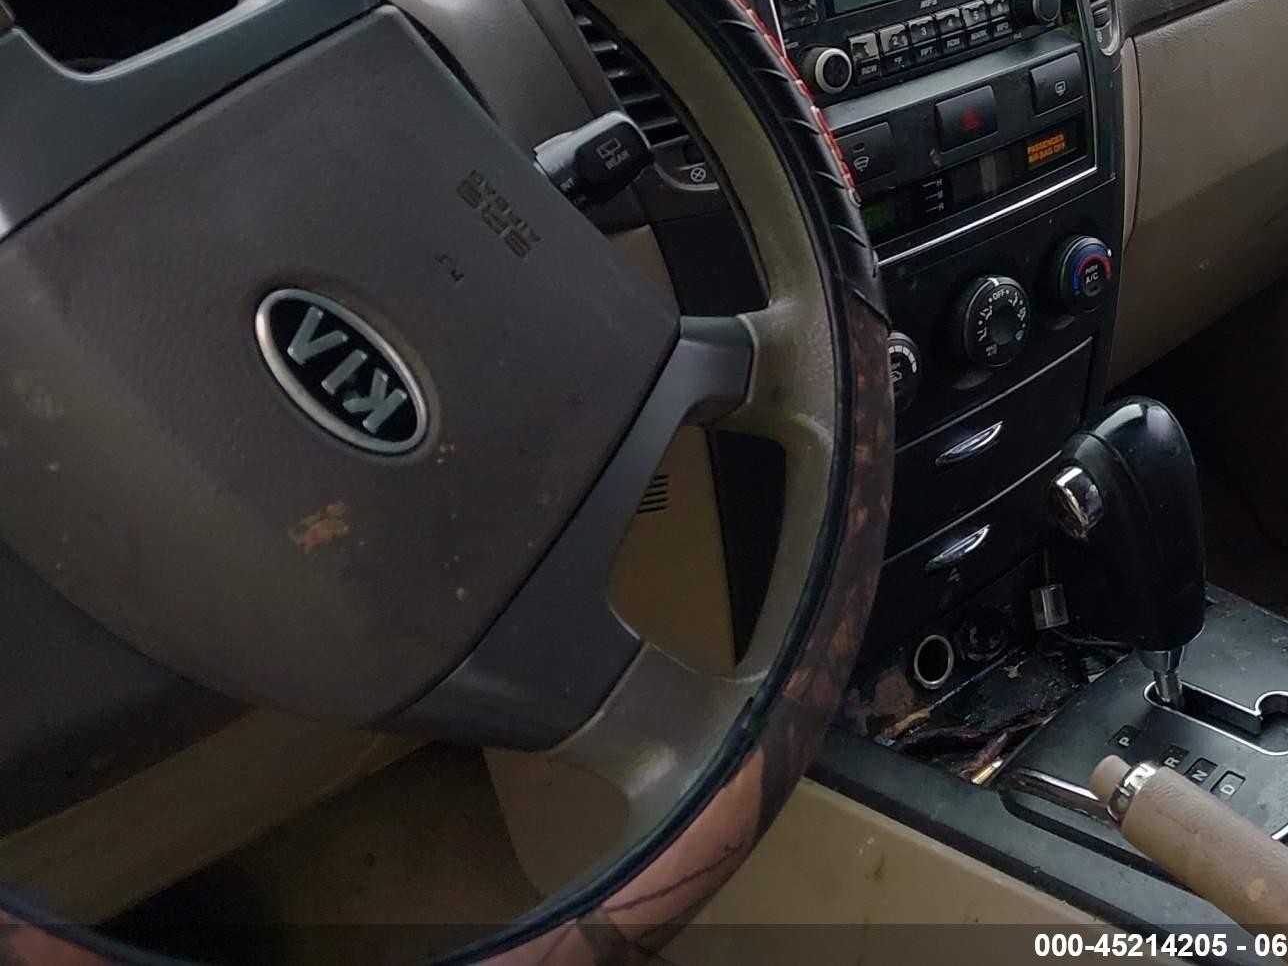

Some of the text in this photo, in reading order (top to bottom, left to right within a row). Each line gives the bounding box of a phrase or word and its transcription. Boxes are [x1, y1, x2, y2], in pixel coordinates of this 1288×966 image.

[972, 10, 980, 21] 5
[920, 26, 927, 36] 3
[891, 35, 899, 46] 2
[1085, 272, 1100, 285] A/C
[992, 288, 1006, 301] OFF
[286, 305, 409, 434] KIA
[1118, 736, 1131, 748] P
[1163, 756, 1180, 769] R
[1191, 769, 1209, 782] N
[1220, 784, 1236, 795] D
